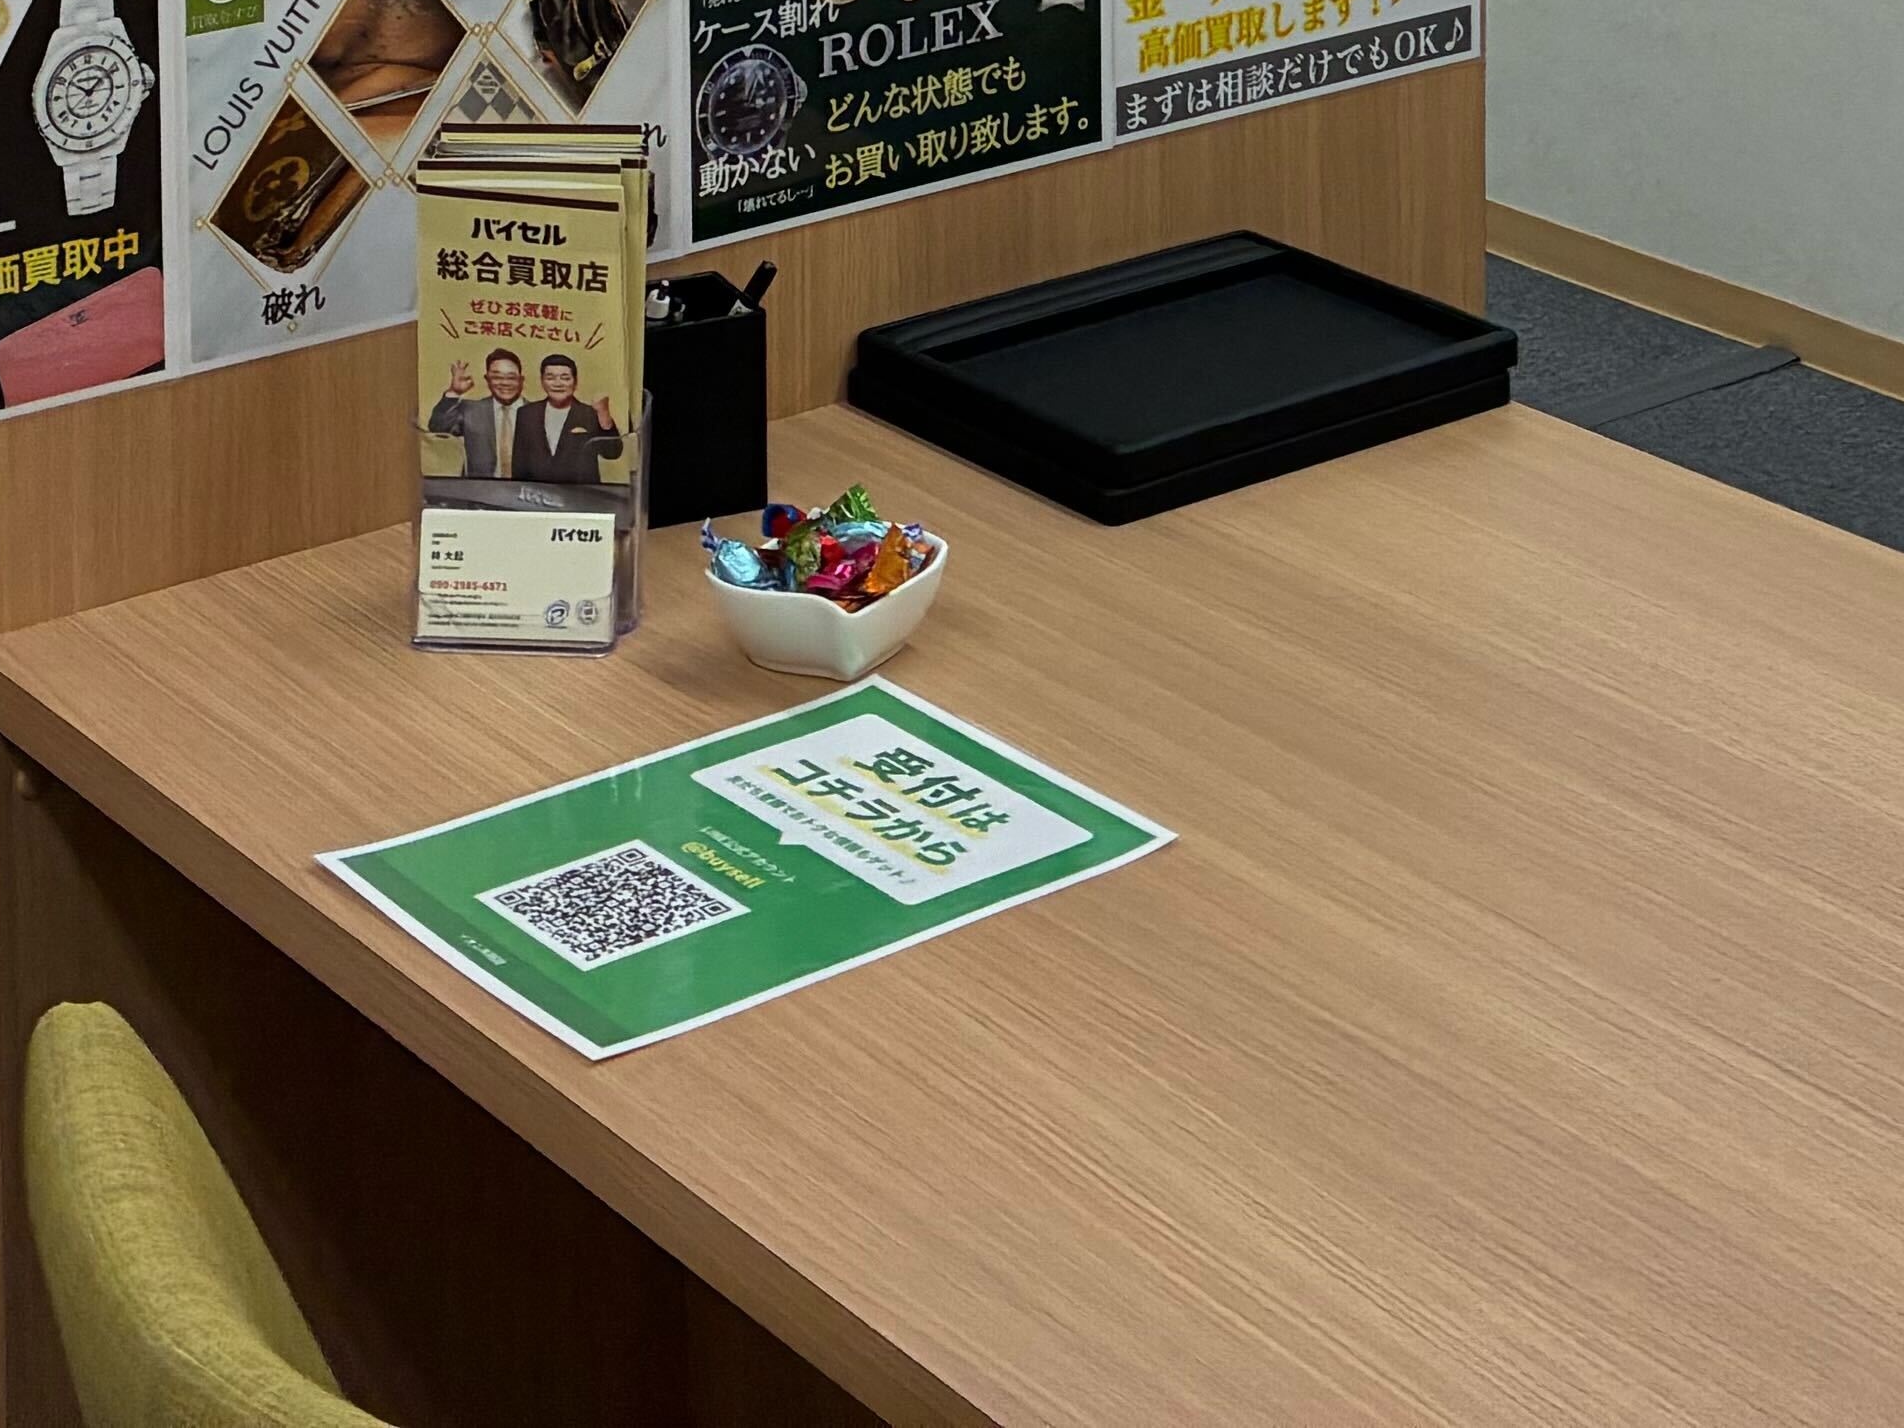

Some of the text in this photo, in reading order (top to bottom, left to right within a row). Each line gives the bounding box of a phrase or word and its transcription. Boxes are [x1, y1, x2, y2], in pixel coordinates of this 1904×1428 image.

[827, 56, 1027, 134] どんな状態でも
[192, 76, 264, 172] LOUIS
[825, 96, 1089, 190] お買い取り致します。
[698, 144, 816, 198] 動かない
[471, 217, 567, 246] バイセル
[436, 248, 609, 294] 総合買取店
[261, 282, 326, 326] 破れ
[469, 298, 573, 321] ぜひお気軽に
[463, 319, 580, 344] ご来店ください
[550, 527, 603, 543] バイセル
[772, 758, 968, 866] コチラから
[853, 747, 1012, 833] 受付は
[681, 841, 767, 889] @buysell
